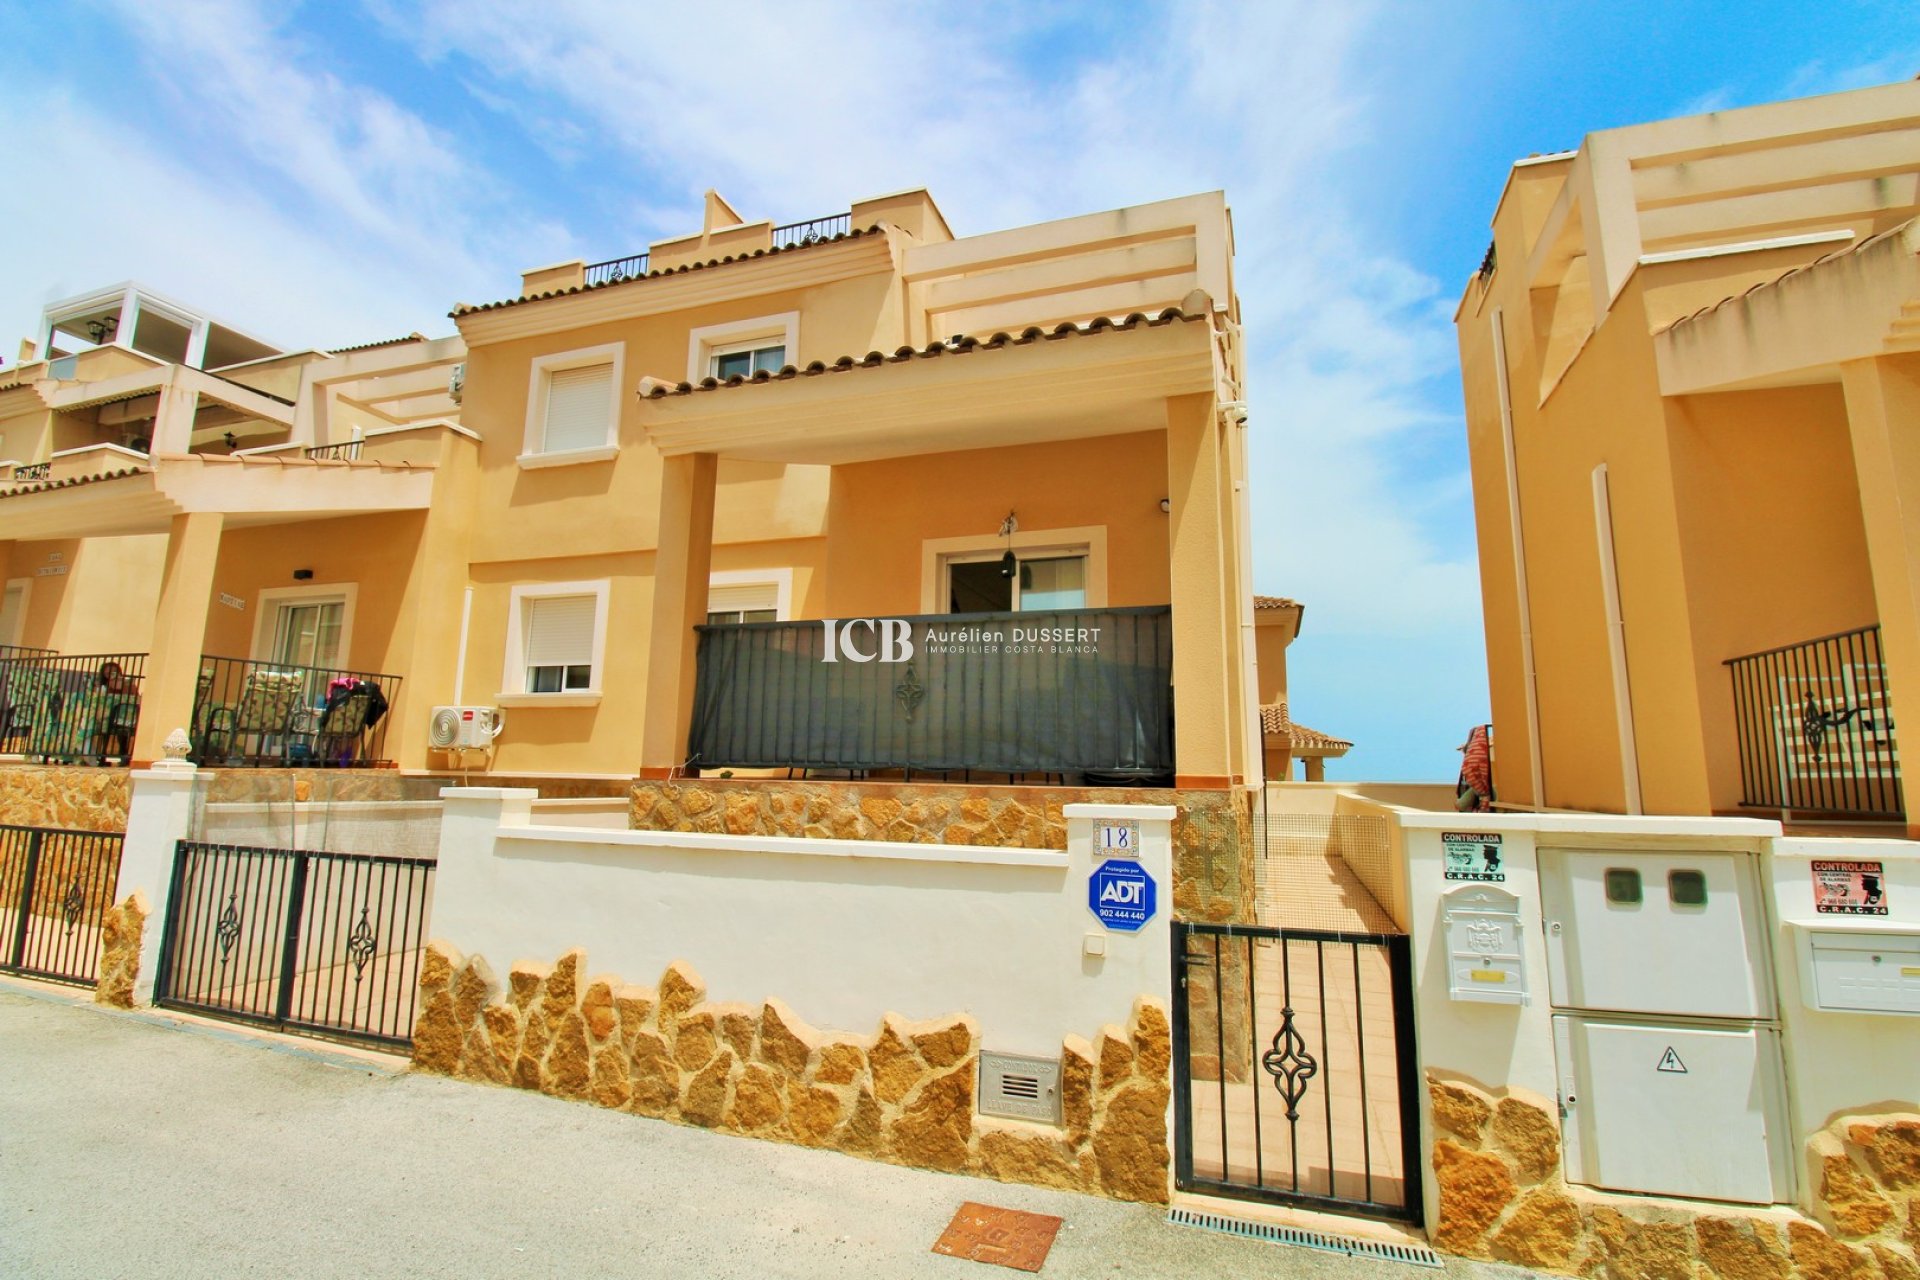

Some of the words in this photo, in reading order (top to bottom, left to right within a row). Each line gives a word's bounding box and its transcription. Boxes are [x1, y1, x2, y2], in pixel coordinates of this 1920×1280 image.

[1106, 827, 1128, 848] 18
[1444, 834, 1500, 842] CONTROLADA
[1813, 862, 1881, 871] CONTROLADA
[1100, 880, 1145, 904] ADT
[1100, 908, 1114, 917] 902
[1115, 910, 1129, 919] 444
[1130, 911, 1145, 920] 440
[1873, 907, 1887, 915] 24
